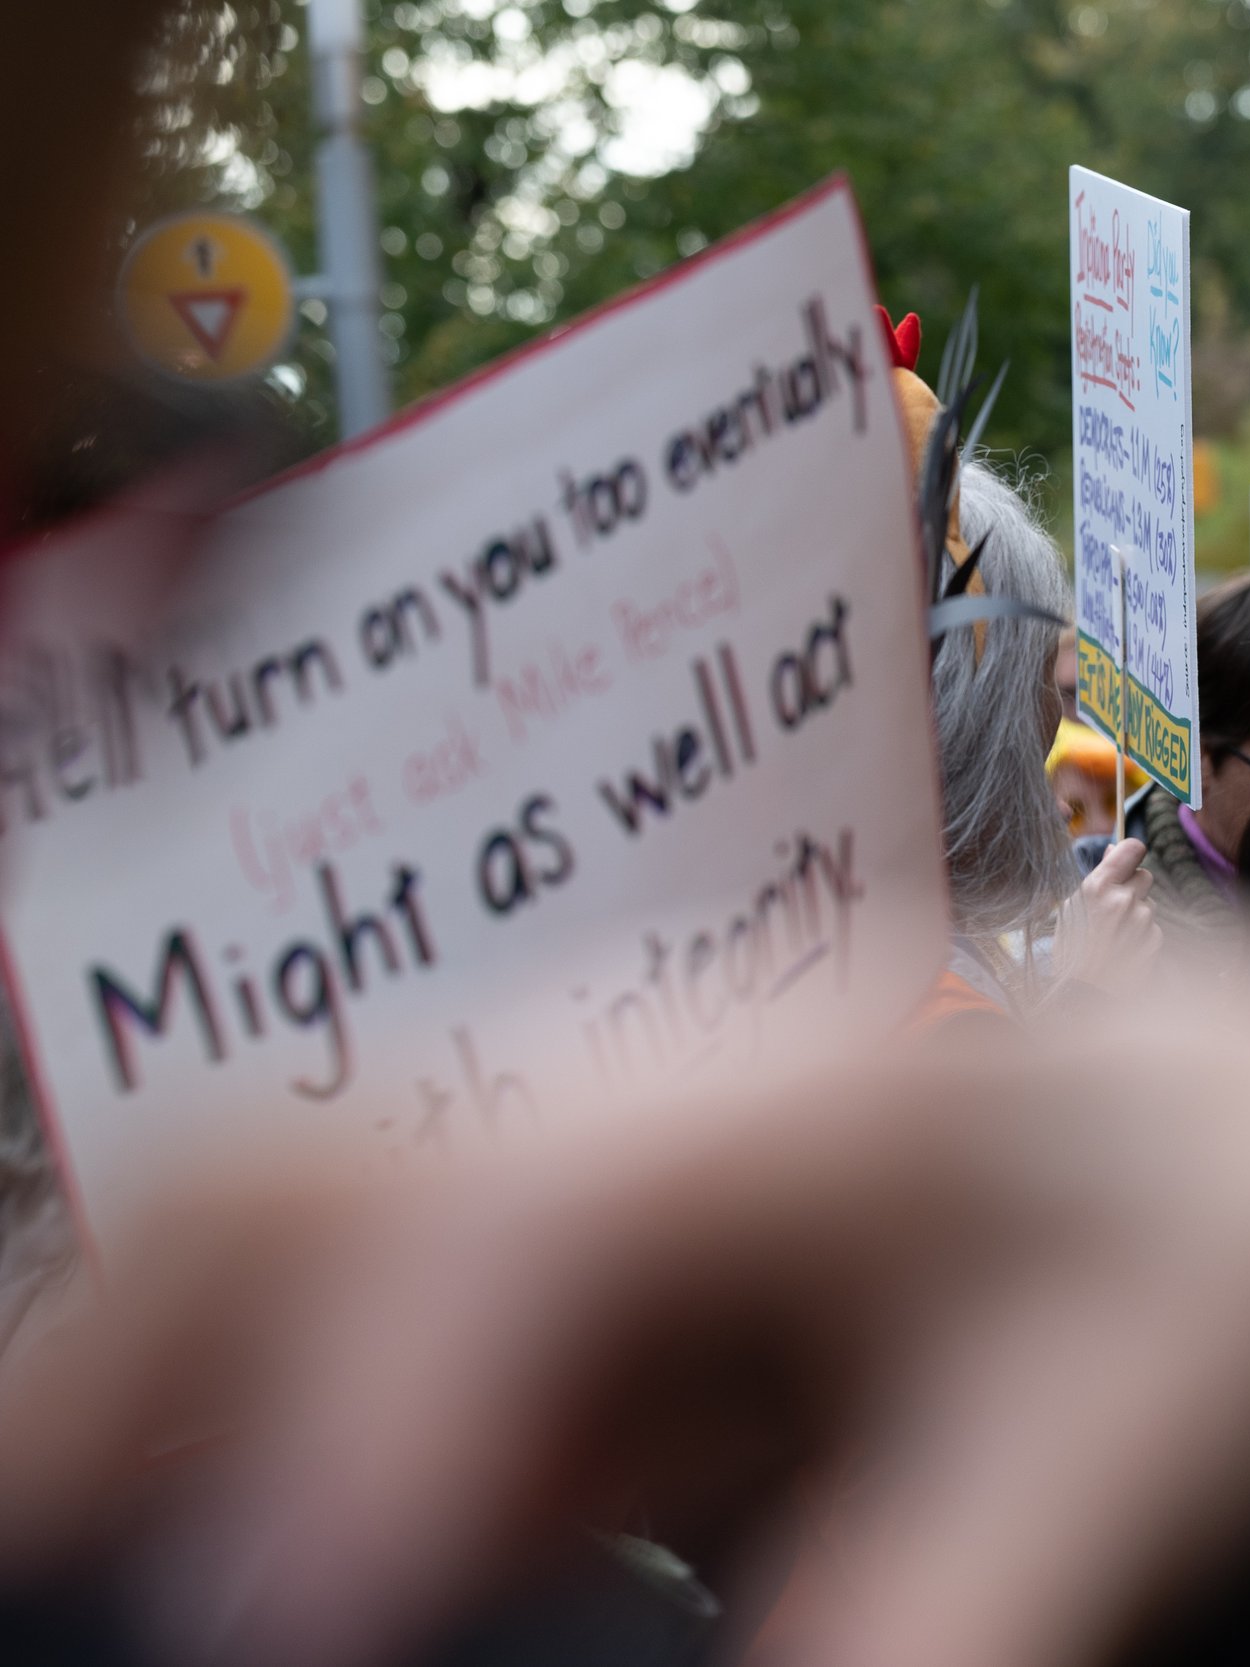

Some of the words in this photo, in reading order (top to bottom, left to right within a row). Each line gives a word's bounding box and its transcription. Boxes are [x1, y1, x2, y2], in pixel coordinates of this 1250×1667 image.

[167, 634, 346, 769] turn
[358, 582, 441, 672] on
[436, 510, 561, 691] you
[556, 454, 649, 553] too
[1153, 444, 1175, 522] (25%)
[86, 859, 437, 1104] Might
[475, 791, 576, 920] as
[596, 638, 759, 840] well
[768, 592, 857, 736] act
